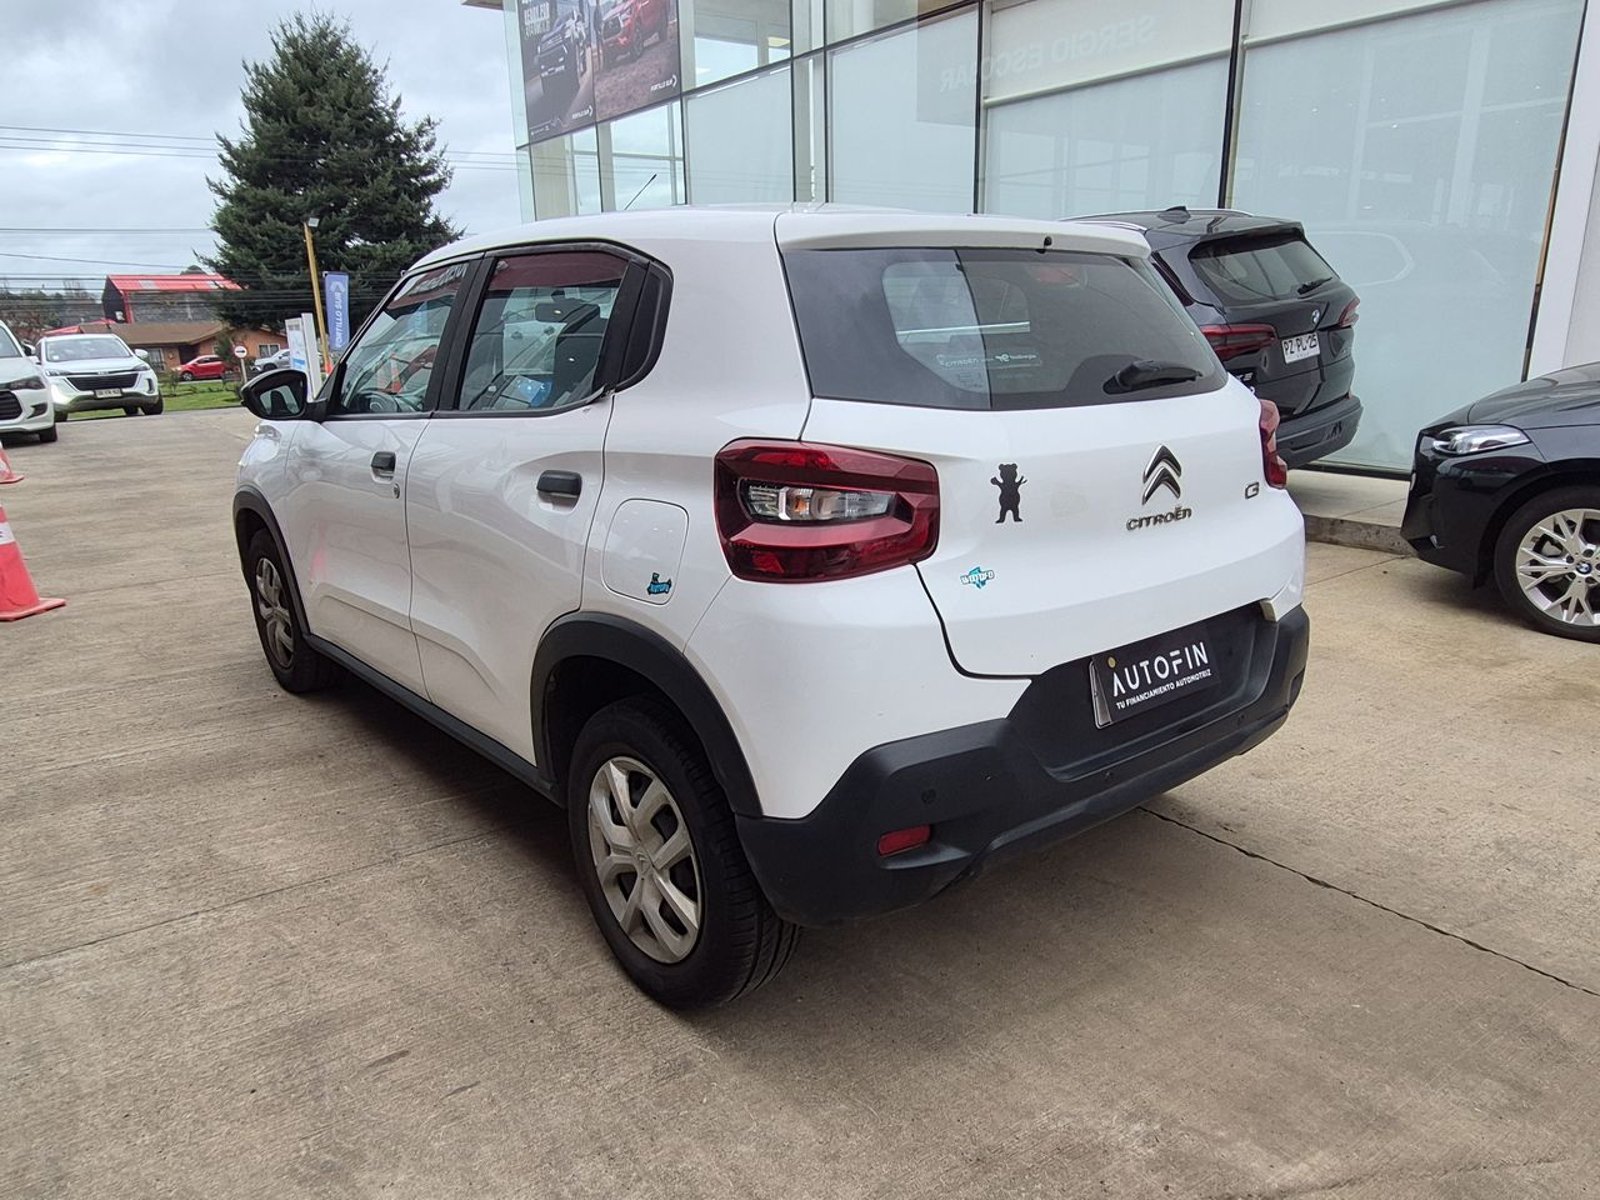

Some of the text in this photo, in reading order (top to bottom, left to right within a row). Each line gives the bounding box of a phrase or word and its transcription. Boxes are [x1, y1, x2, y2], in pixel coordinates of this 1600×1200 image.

[1113, 641, 1209, 698] AUTOFIN
[1116, 668, 1213, 710] TU FINANCIAMIENTO AUTOMOTRIZ
